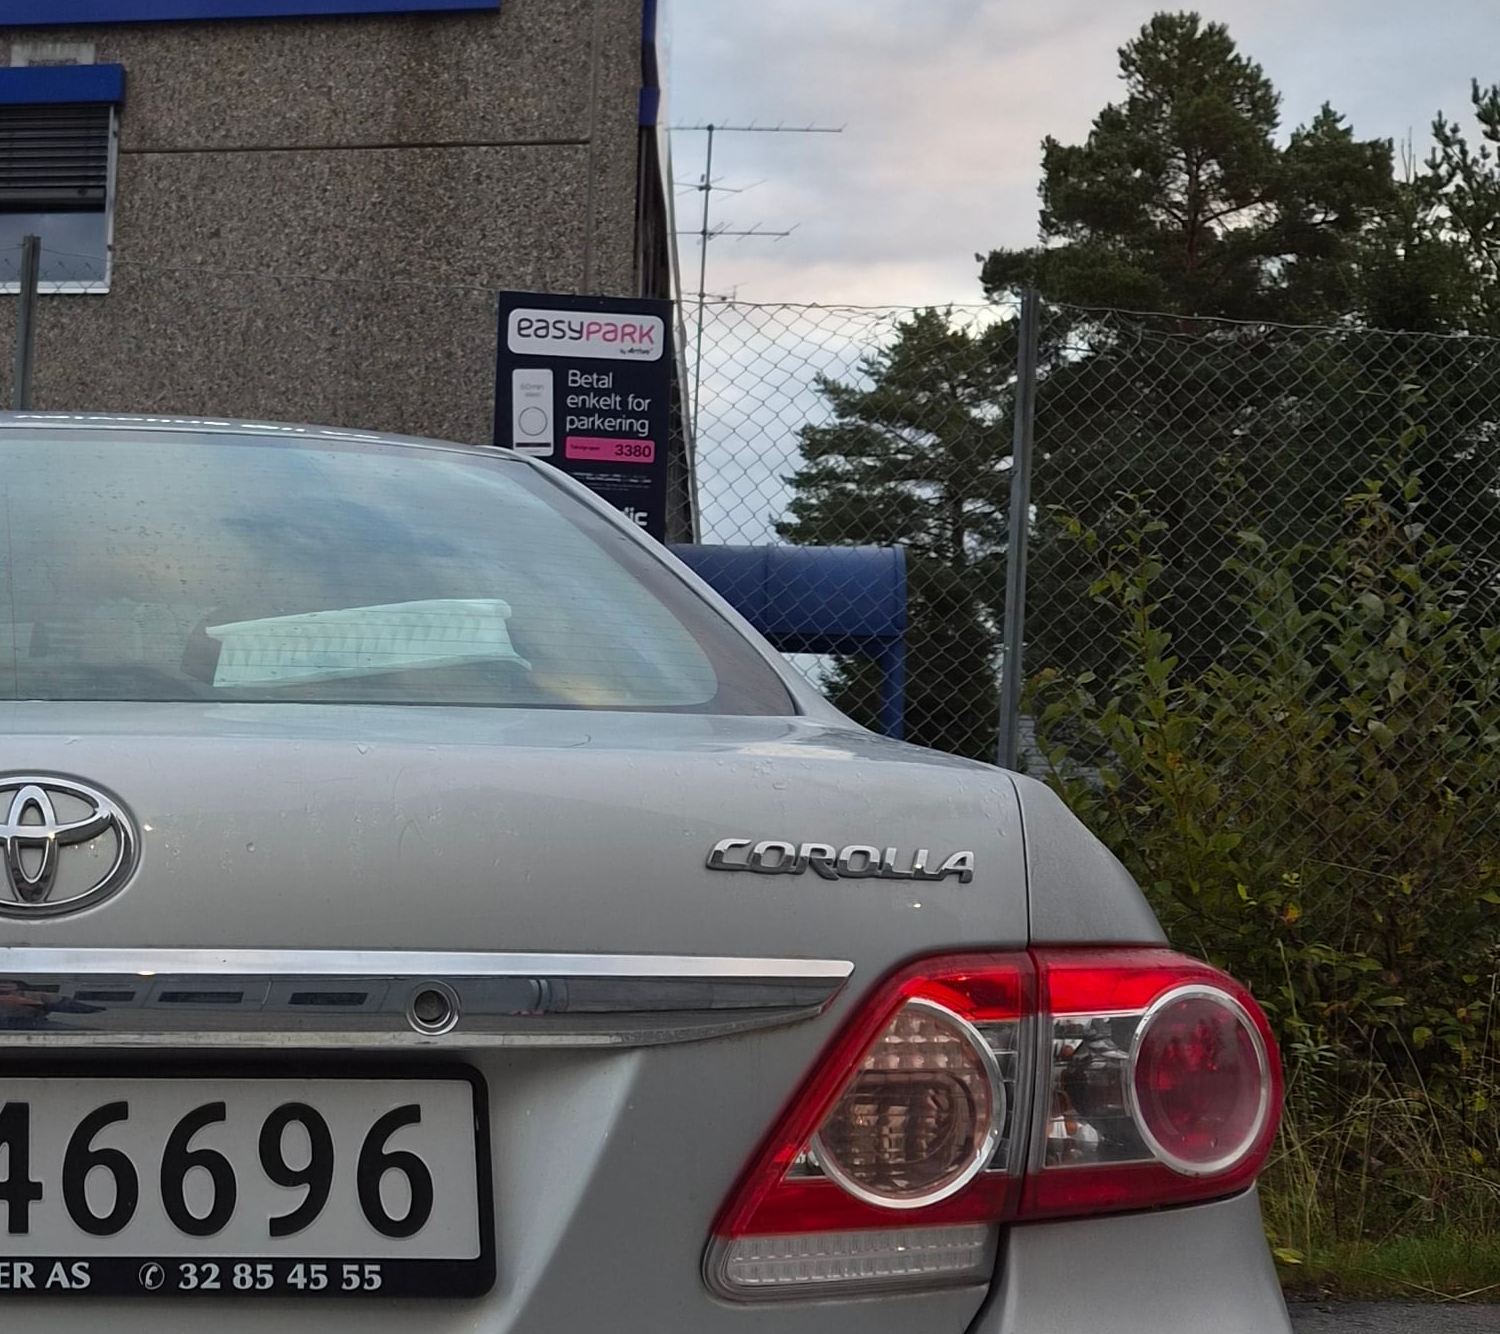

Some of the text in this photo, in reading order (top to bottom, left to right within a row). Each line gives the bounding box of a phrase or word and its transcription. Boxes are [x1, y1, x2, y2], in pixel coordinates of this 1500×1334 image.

[568, 369, 613, 388] Betal
[566, 391, 652, 411] enkelt for
[566, 413, 649, 437] parkering
[614, 444, 652, 458] 3380
[705, 838, 975, 883] COROLLA
[44, 1261, 91, 1289] AS
[177, 1263, 382, 1290] 32 85 45 55
